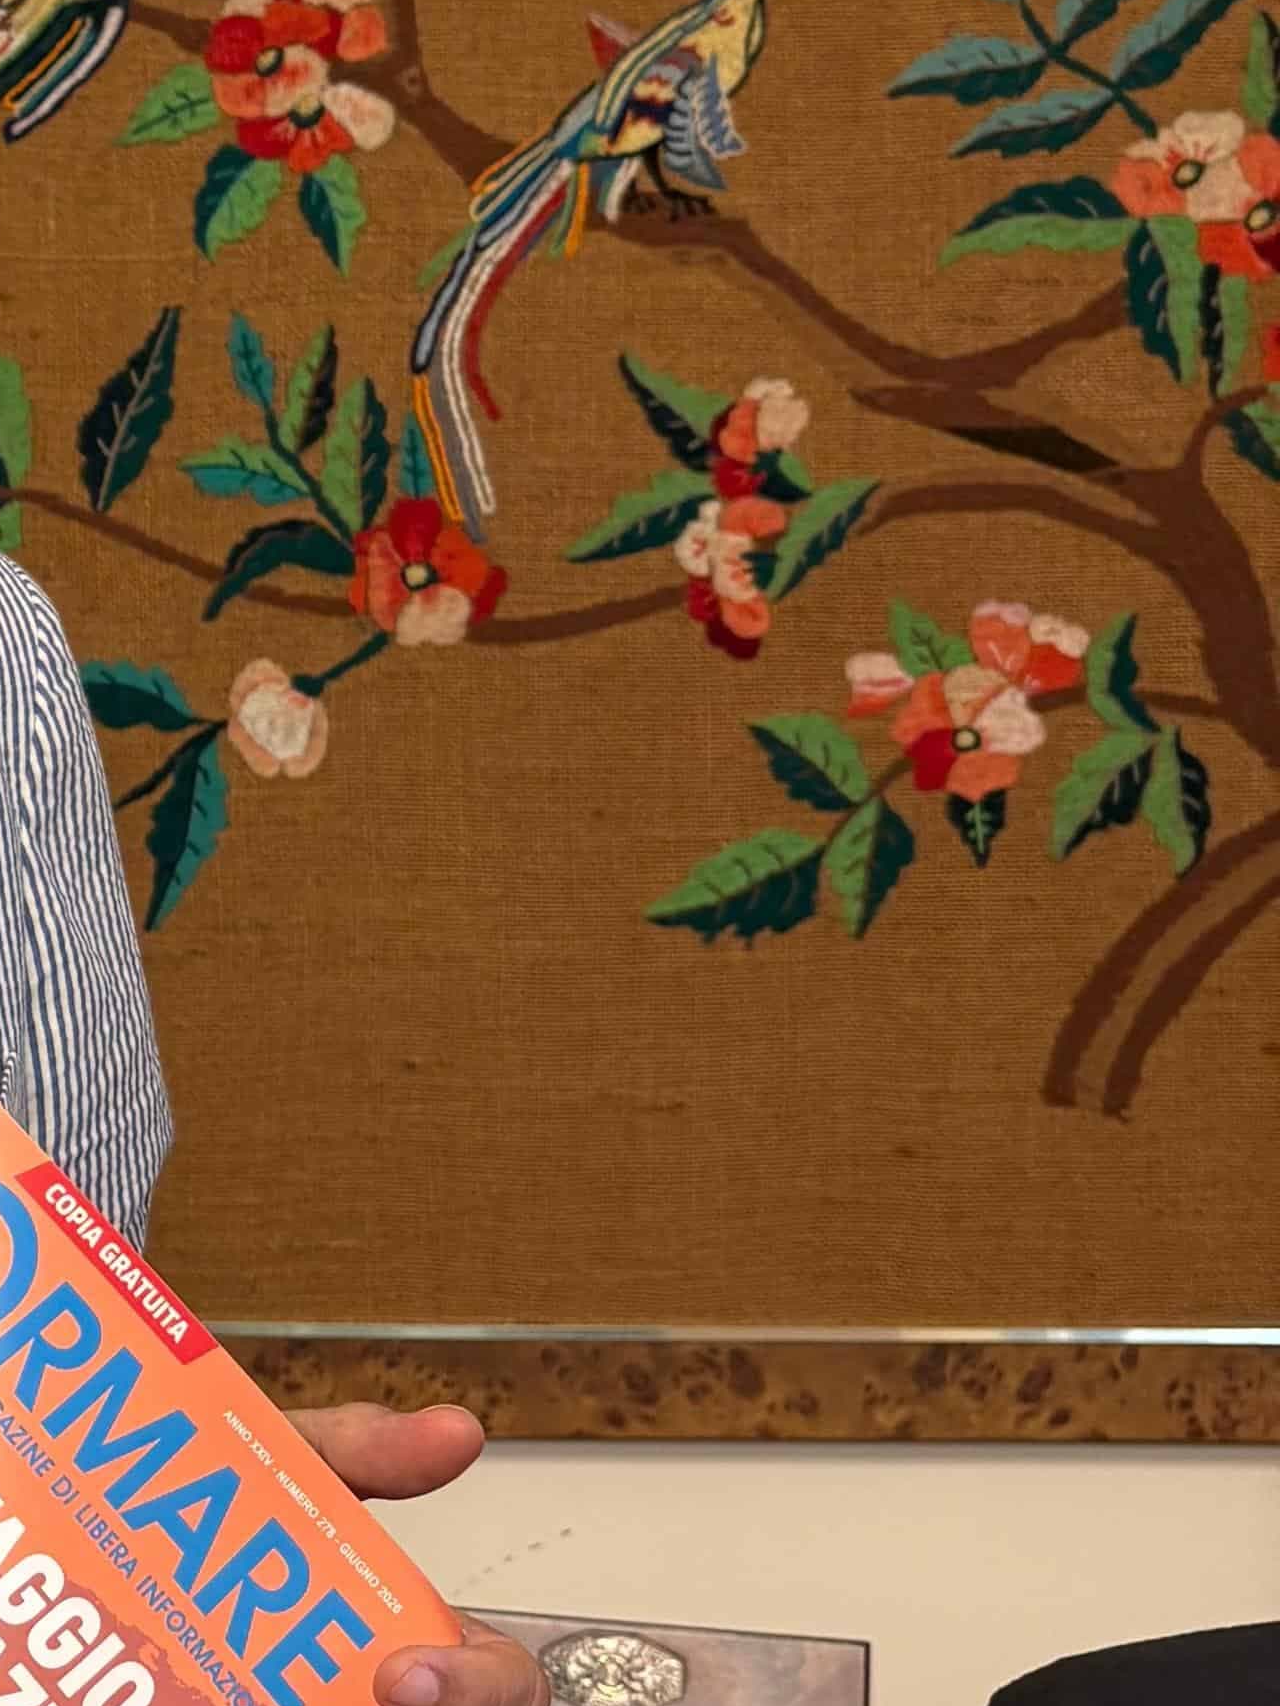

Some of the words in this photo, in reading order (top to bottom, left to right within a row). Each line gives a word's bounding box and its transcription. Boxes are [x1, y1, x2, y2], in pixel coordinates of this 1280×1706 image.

[44, 1183, 104, 1249] COPIA
[98, 1242, 189, 1344] GRATUITA
[51, 1475, 80, 1506] DI
[74, 1503, 138, 1580] LIBERA
